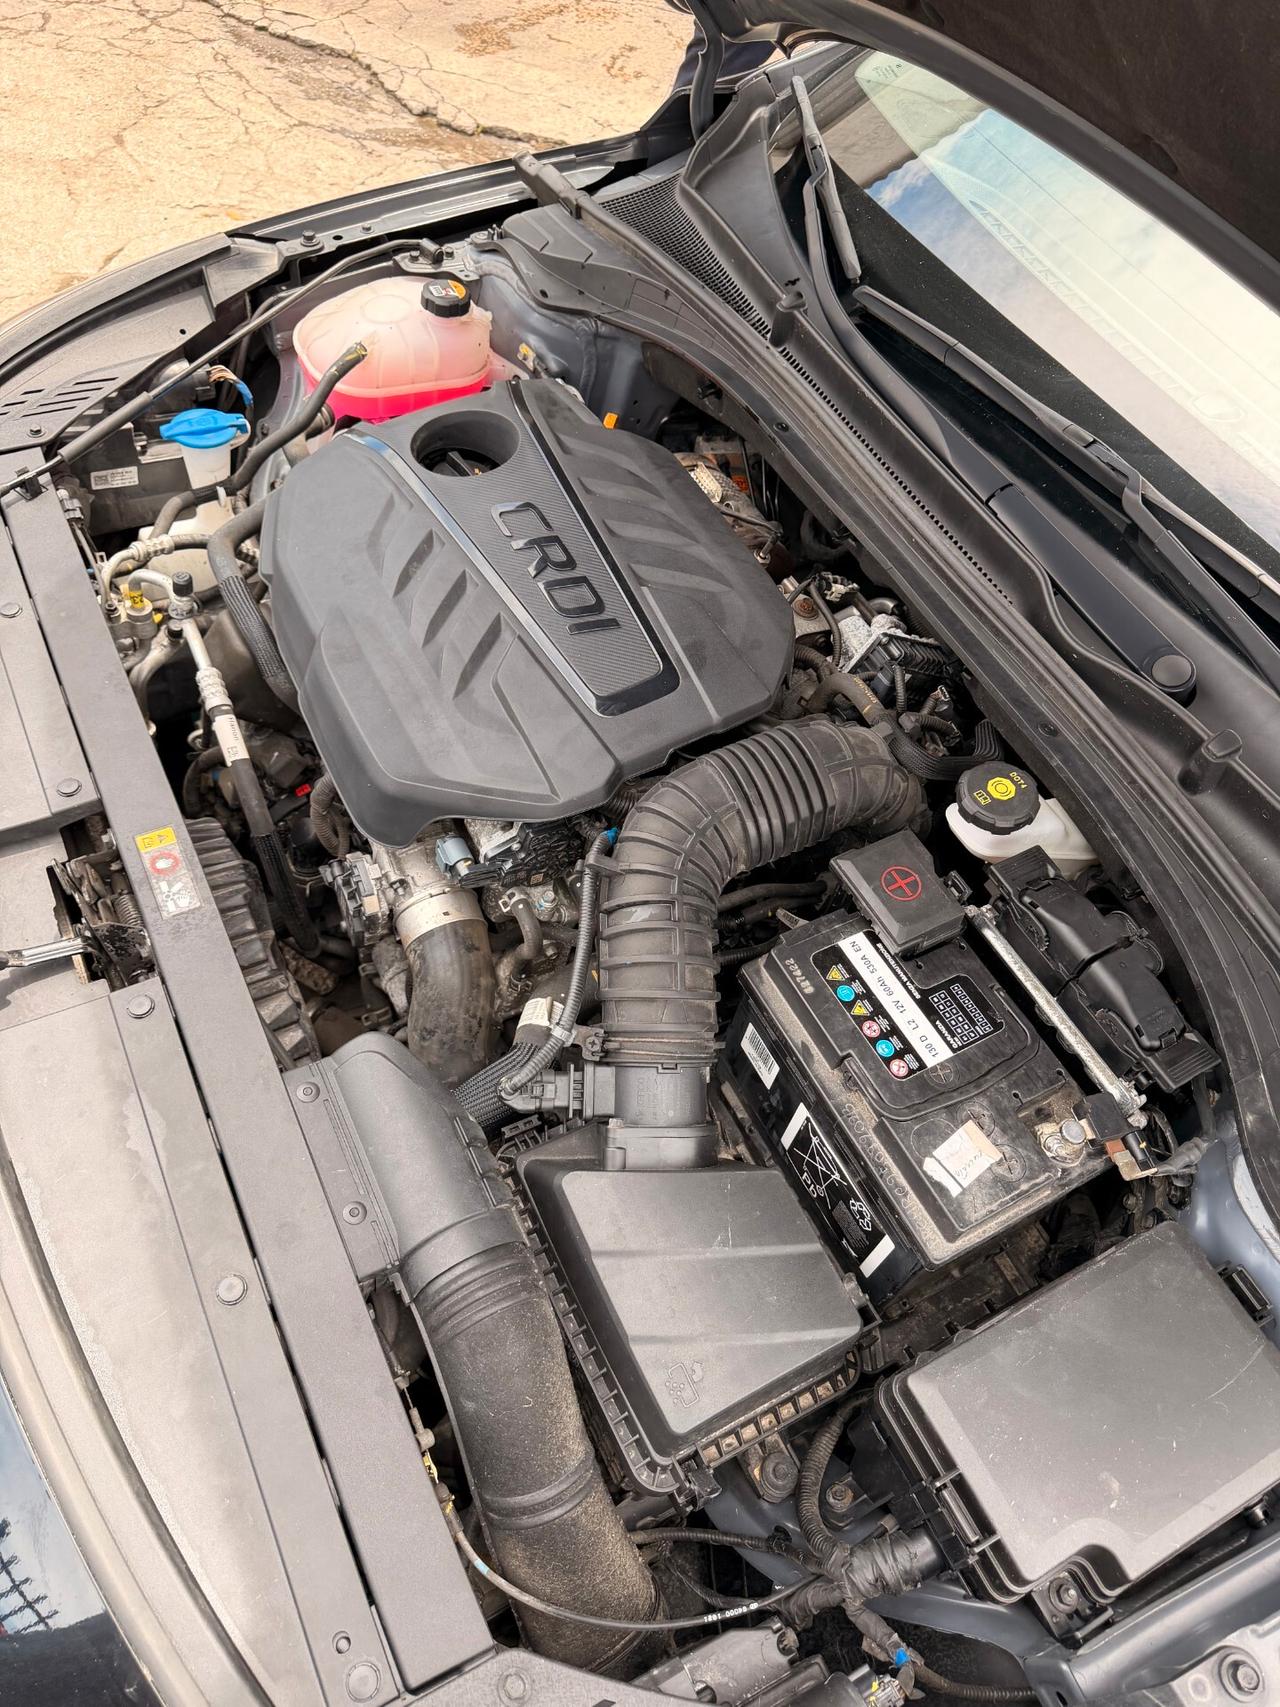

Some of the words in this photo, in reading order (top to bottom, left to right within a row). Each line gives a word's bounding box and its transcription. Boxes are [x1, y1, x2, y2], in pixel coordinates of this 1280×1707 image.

[490, 501, 620, 635] CRDI
[849, 940, 862, 953] EN
[860, 954, 878, 974] 530A
[877, 976, 894, 997] 60Ah
[891, 999, 907, 1014] 12V
[907, 1018, 919, 1031] L2
[919, 1035, 928, 1043] D
[924, 1041, 940, 1058] 130
[801, 1174, 818, 1198] Pb
